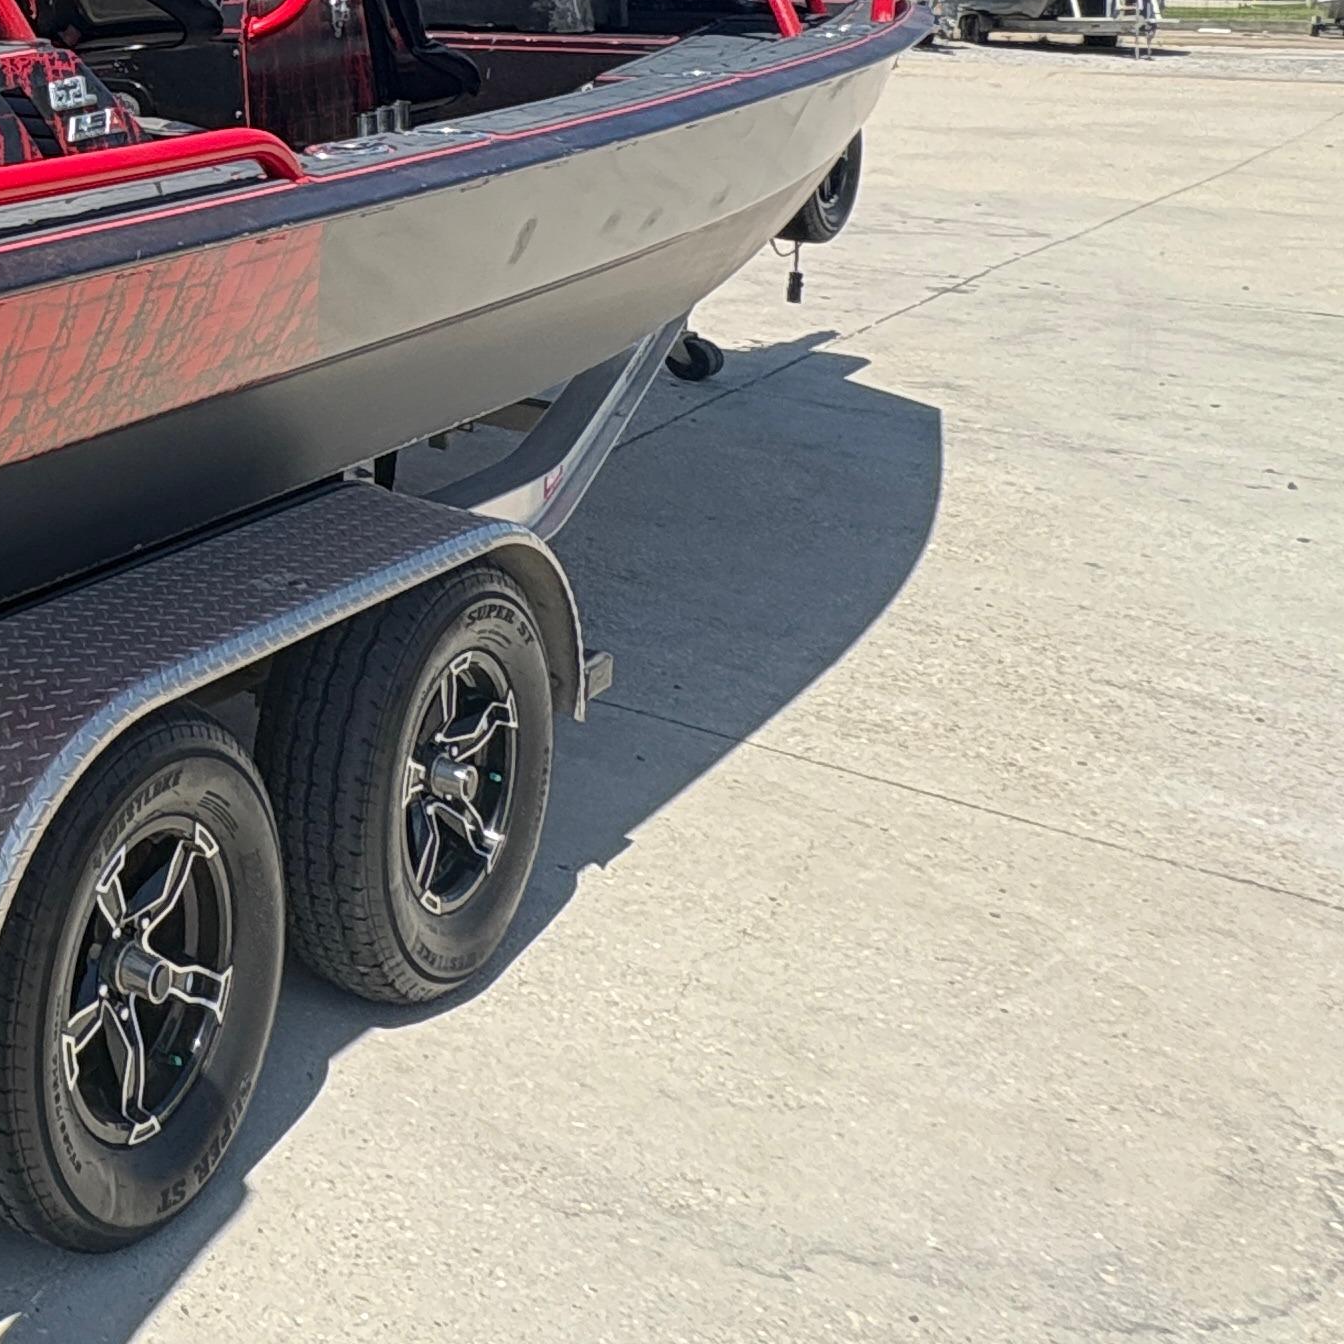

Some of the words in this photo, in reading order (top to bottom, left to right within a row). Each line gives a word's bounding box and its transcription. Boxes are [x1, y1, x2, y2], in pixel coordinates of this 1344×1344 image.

[466, 604, 515, 628] SUPER
[516, 620, 535, 646] ST
[157, 1178, 188, 1214] ST
